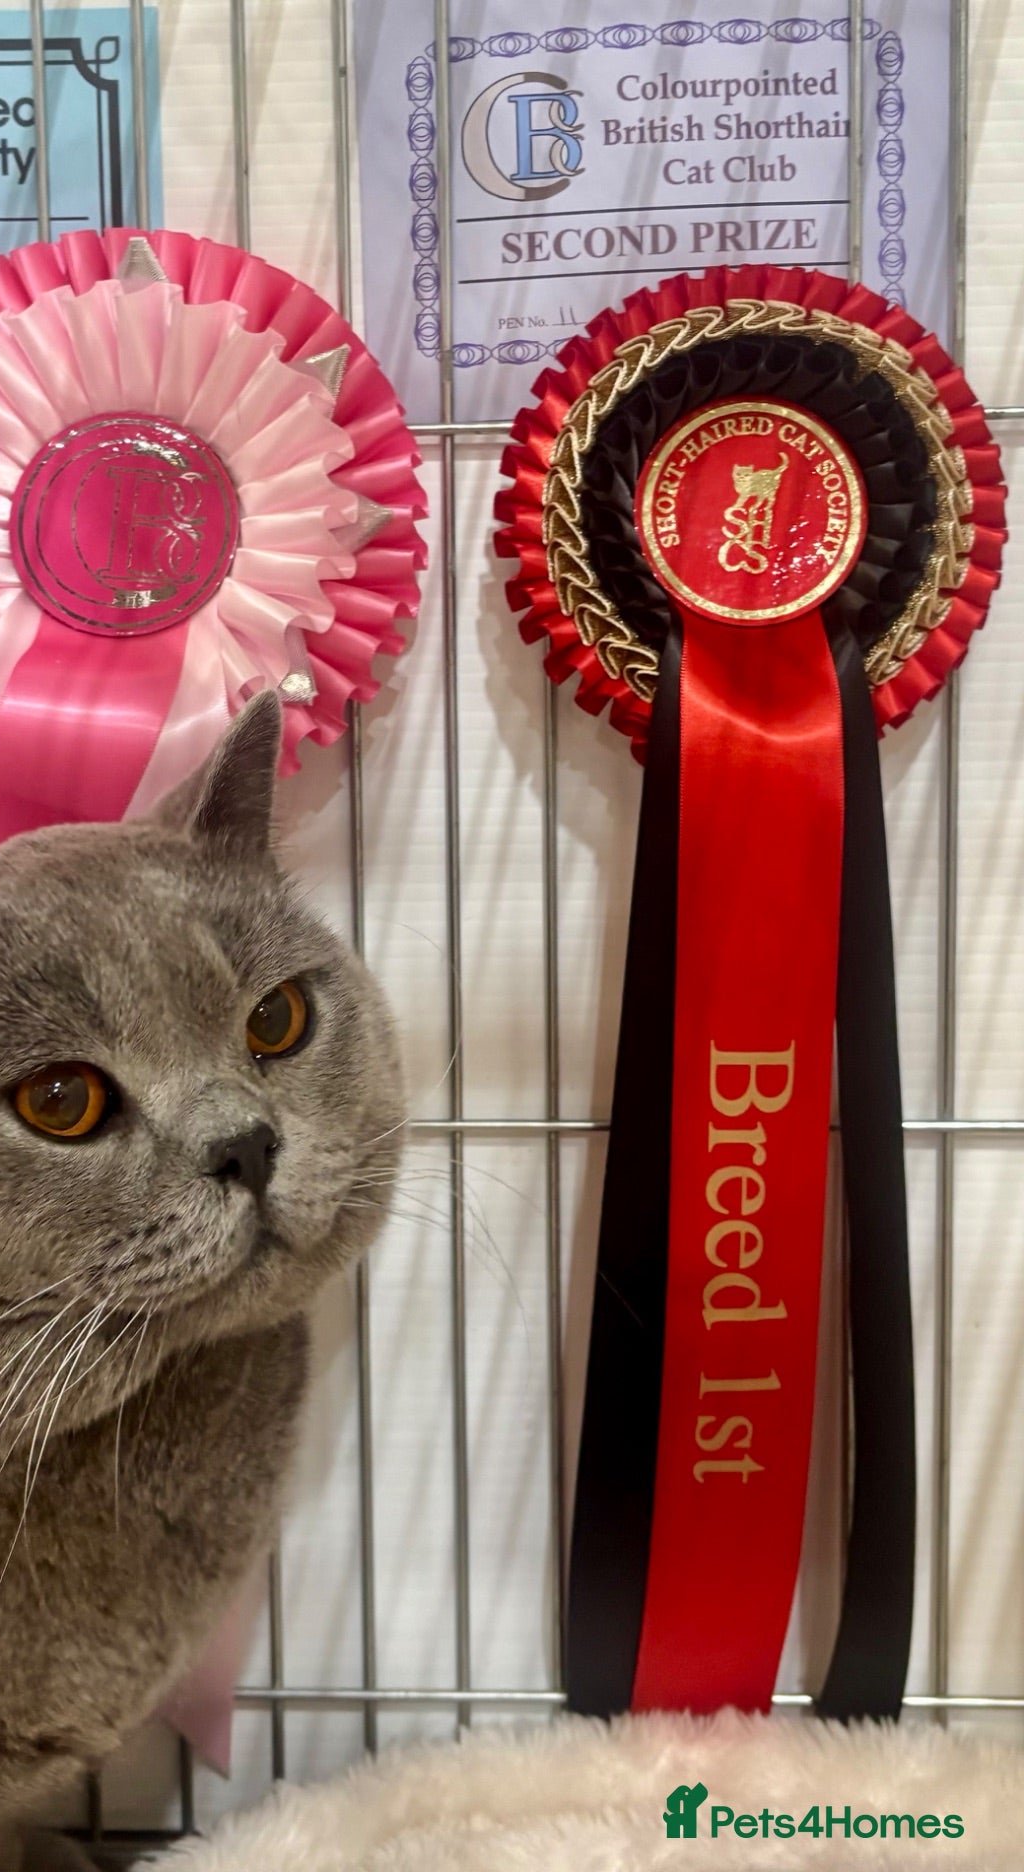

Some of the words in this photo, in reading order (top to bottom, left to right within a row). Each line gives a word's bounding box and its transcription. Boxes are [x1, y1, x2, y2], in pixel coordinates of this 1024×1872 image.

[616, 67, 839, 106] Colourpointed
[601, 115, 704, 146] British
[663, 159, 715, 186] Cat
[722, 155, 797, 184] Club
[501, 223, 678, 265] SECOND
[689, 218, 819, 254] PRIZE
[497, 317, 525, 330] PEN
[655, 416, 775, 549] SHORT-HAIRED
[778, 423, 825, 462] CAT
[814, 459, 849, 566] SOCIETY
[702, 1038, 796, 1331] Breed
